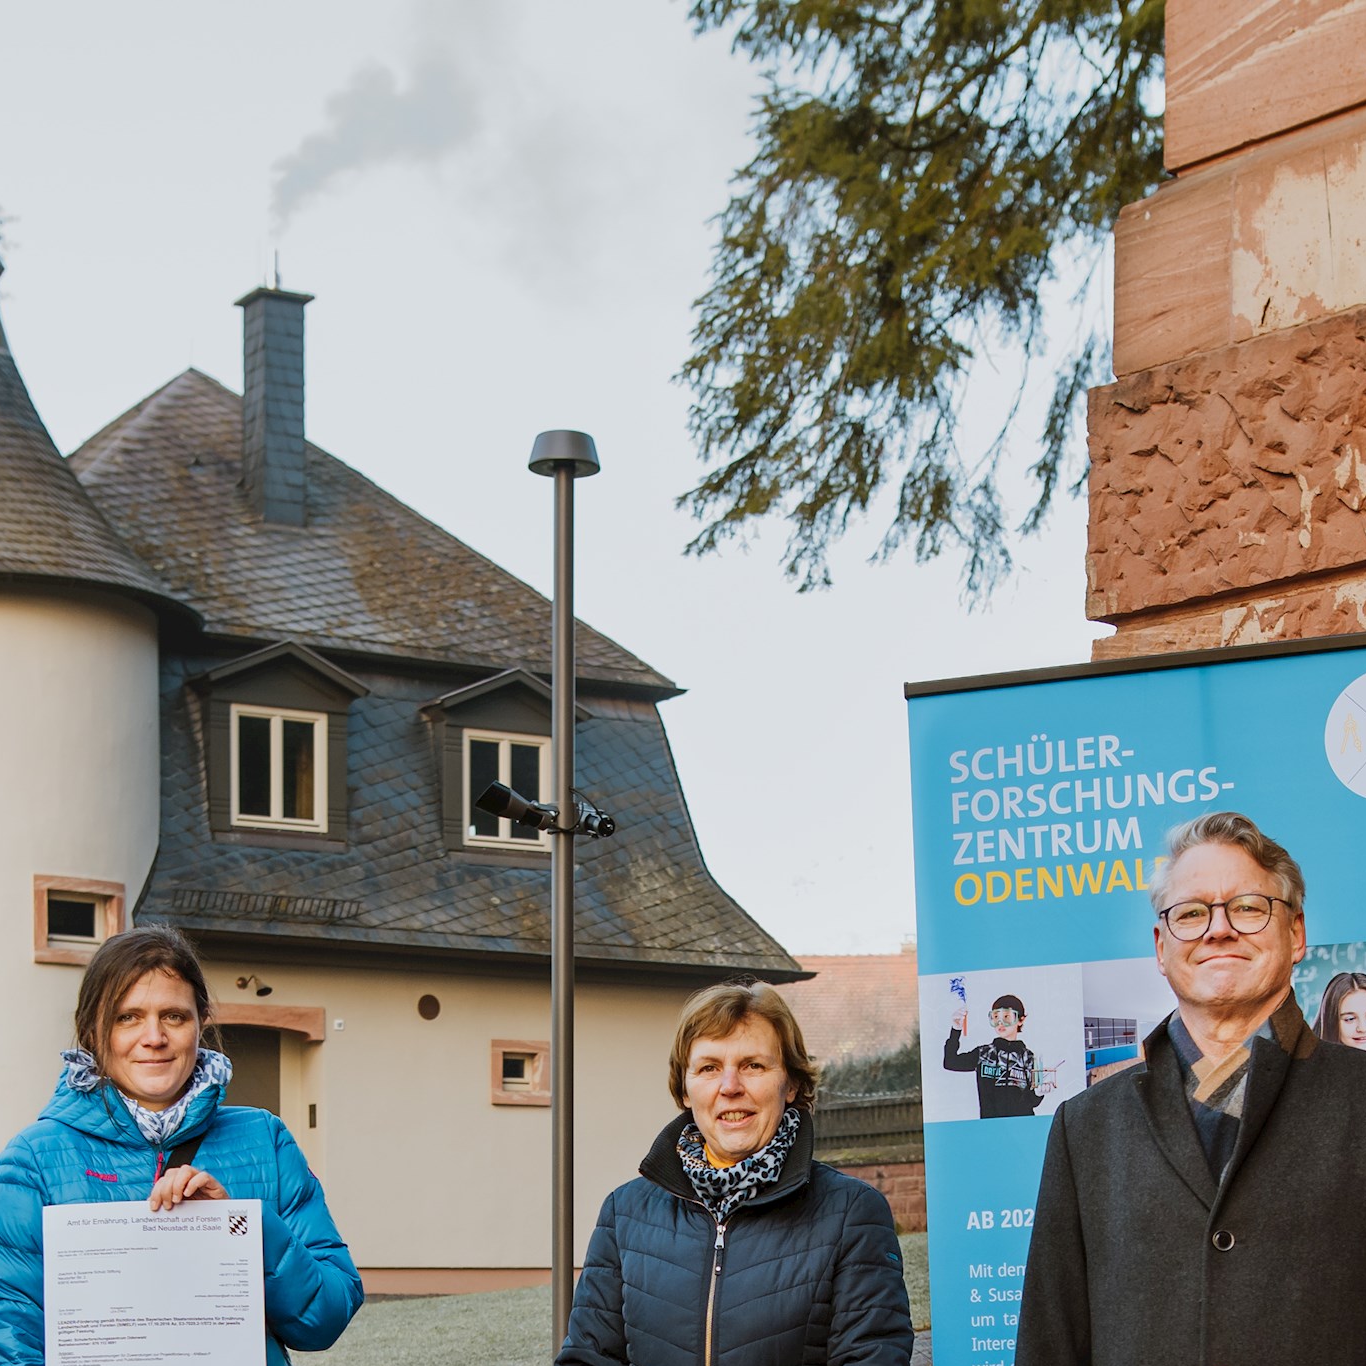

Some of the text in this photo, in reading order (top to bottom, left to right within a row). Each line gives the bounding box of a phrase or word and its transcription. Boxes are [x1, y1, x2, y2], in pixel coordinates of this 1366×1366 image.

[948, 733, 1135, 784] SCHÜLER-
[950, 765, 1235, 824] FORSCHUNGS-
[952, 816, 1143, 866] ZENTRUM
[131, 1215, 180, 1224] Landwirtschaft
[181, 1215, 194, 1224] und
[195, 1215, 222, 1224] Forsten
[966, 1211, 995, 1230] AB
[142, 1224, 156, 1232] Bad
[158, 1224, 189, 1232] Neustadt
[969, 1264, 994, 1279] Mit
[970, 1287, 1023, 1303] & Susa
[970, 1315, 995, 1327] um
[971, 1337, 1016, 1352] Intere
